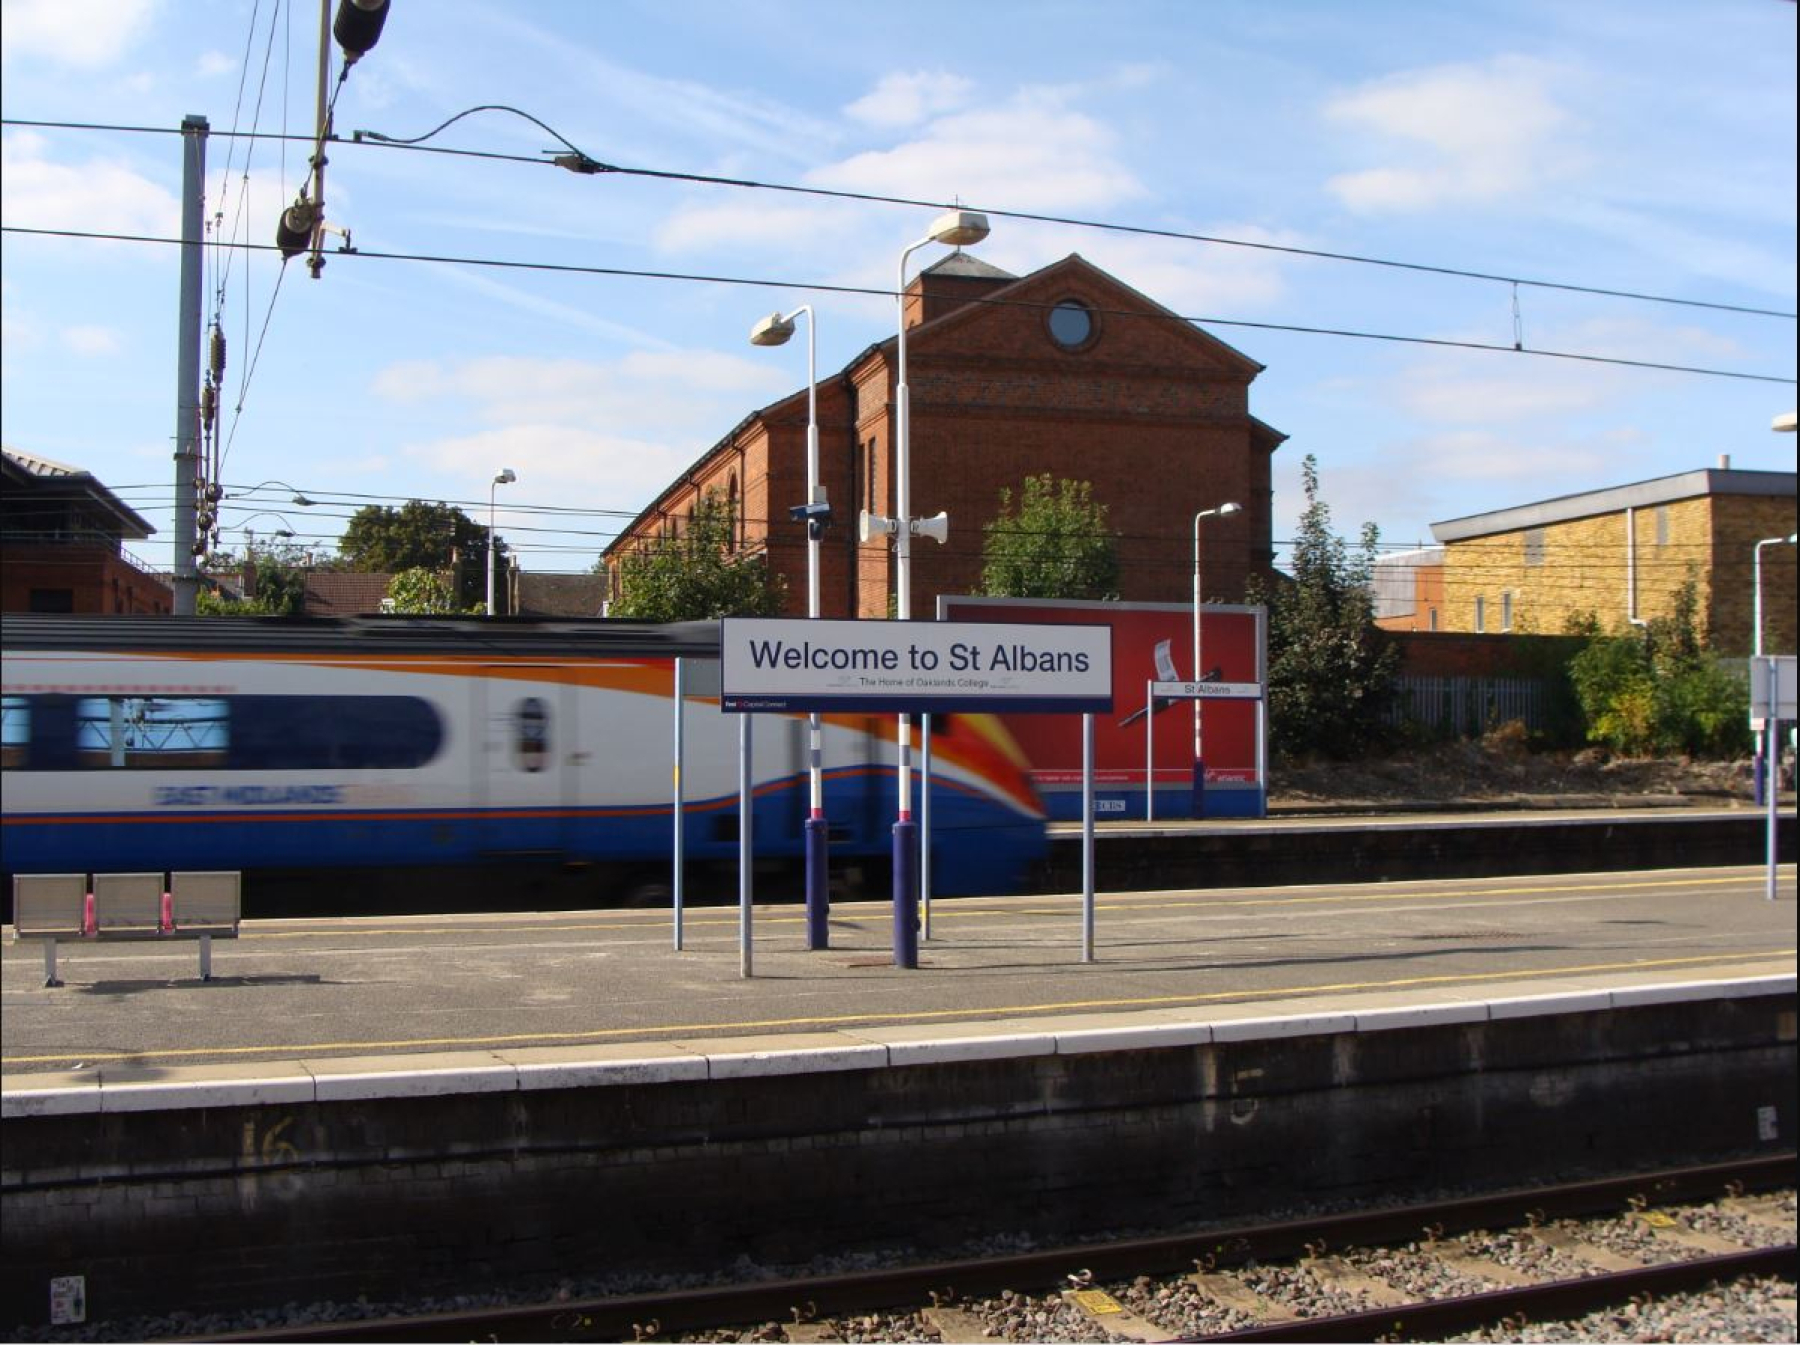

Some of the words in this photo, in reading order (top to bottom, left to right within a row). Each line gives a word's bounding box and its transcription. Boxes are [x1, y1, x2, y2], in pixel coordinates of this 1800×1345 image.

[750, 640, 898, 669] Welcome
[908, 644, 938, 670] to
[950, 643, 980, 671] St
[990, 644, 1089, 673] Albans
[858, 677, 876, 686] The
[878, 677, 903, 687] Home
[905, 677, 915, 687] of
[916, 677, 956, 688] Oaklands
[957, 678, 989, 689] College
[1184, 684, 1195, 694] St
[1197, 684, 1231, 695] Albans
